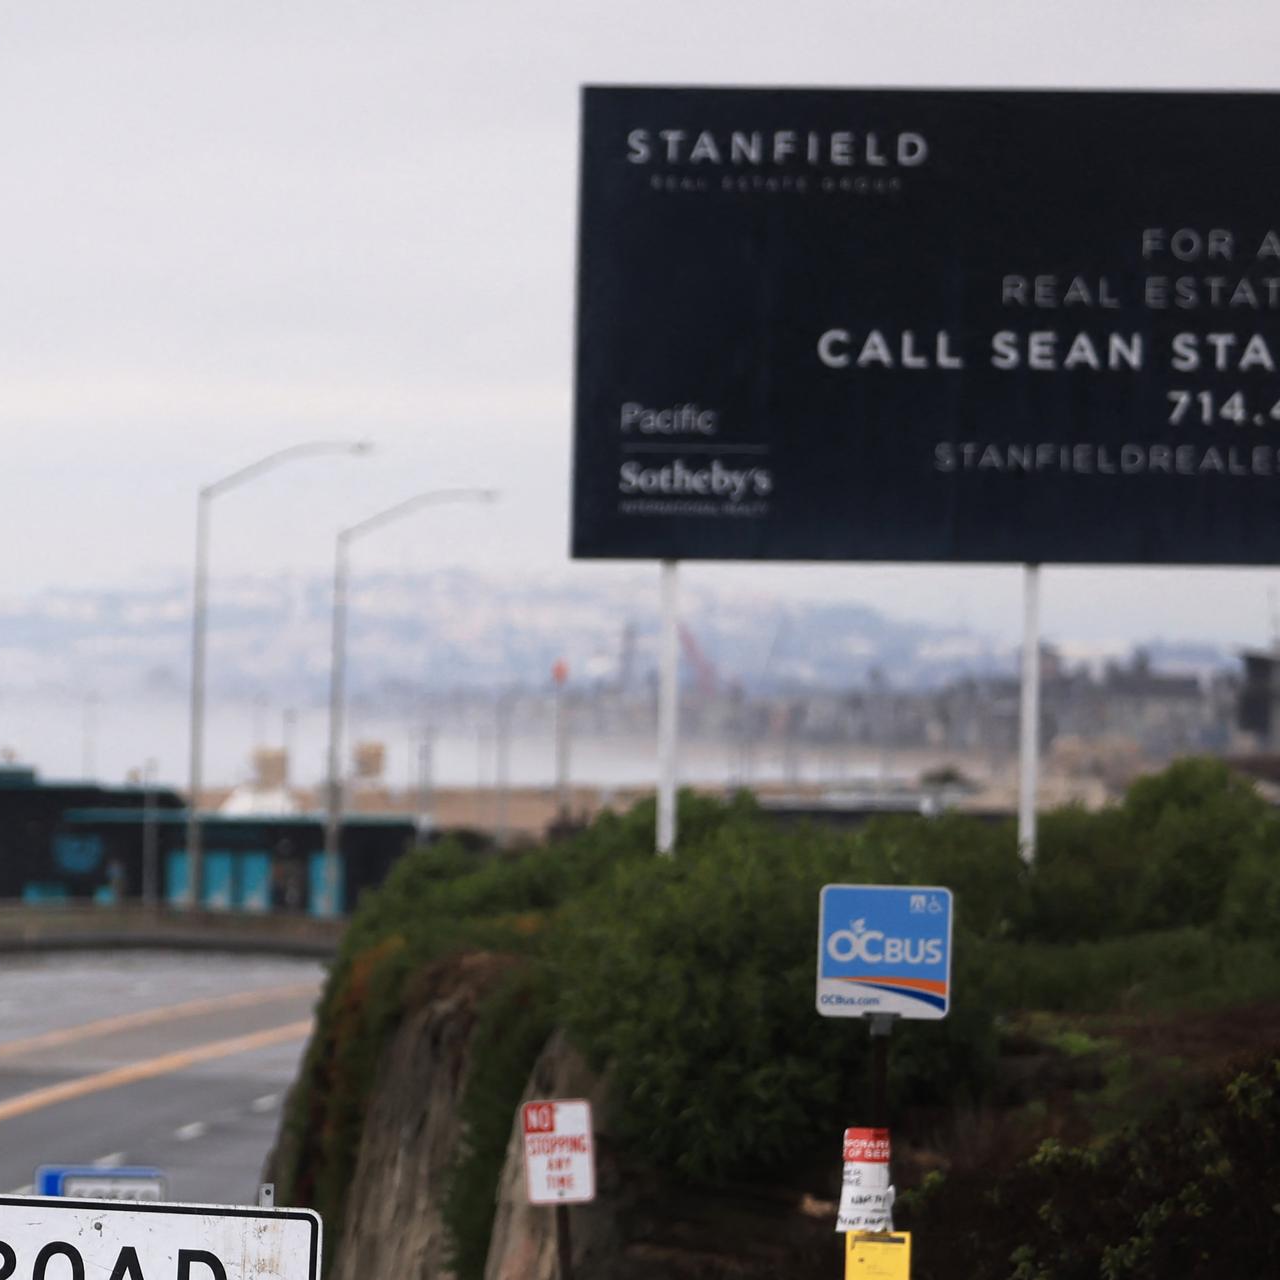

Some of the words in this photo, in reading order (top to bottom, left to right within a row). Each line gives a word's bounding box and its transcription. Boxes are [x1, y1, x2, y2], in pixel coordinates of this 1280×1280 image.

[627, 129, 928, 166] STANFIELD
[1142, 228, 1233, 262] FOR
[1001, 274, 1121, 308] REAL
[817, 328, 963, 369] CALL
[991, 330, 1142, 370] SEAN
[1171, 332, 1274, 372] STA
[621, 402, 716, 435] Pacific
[934, 441, 1280, 476] STANFIELDREALE
[619, 459, 773, 502] Sotheby's
[527, 1105, 553, 1130] NO
